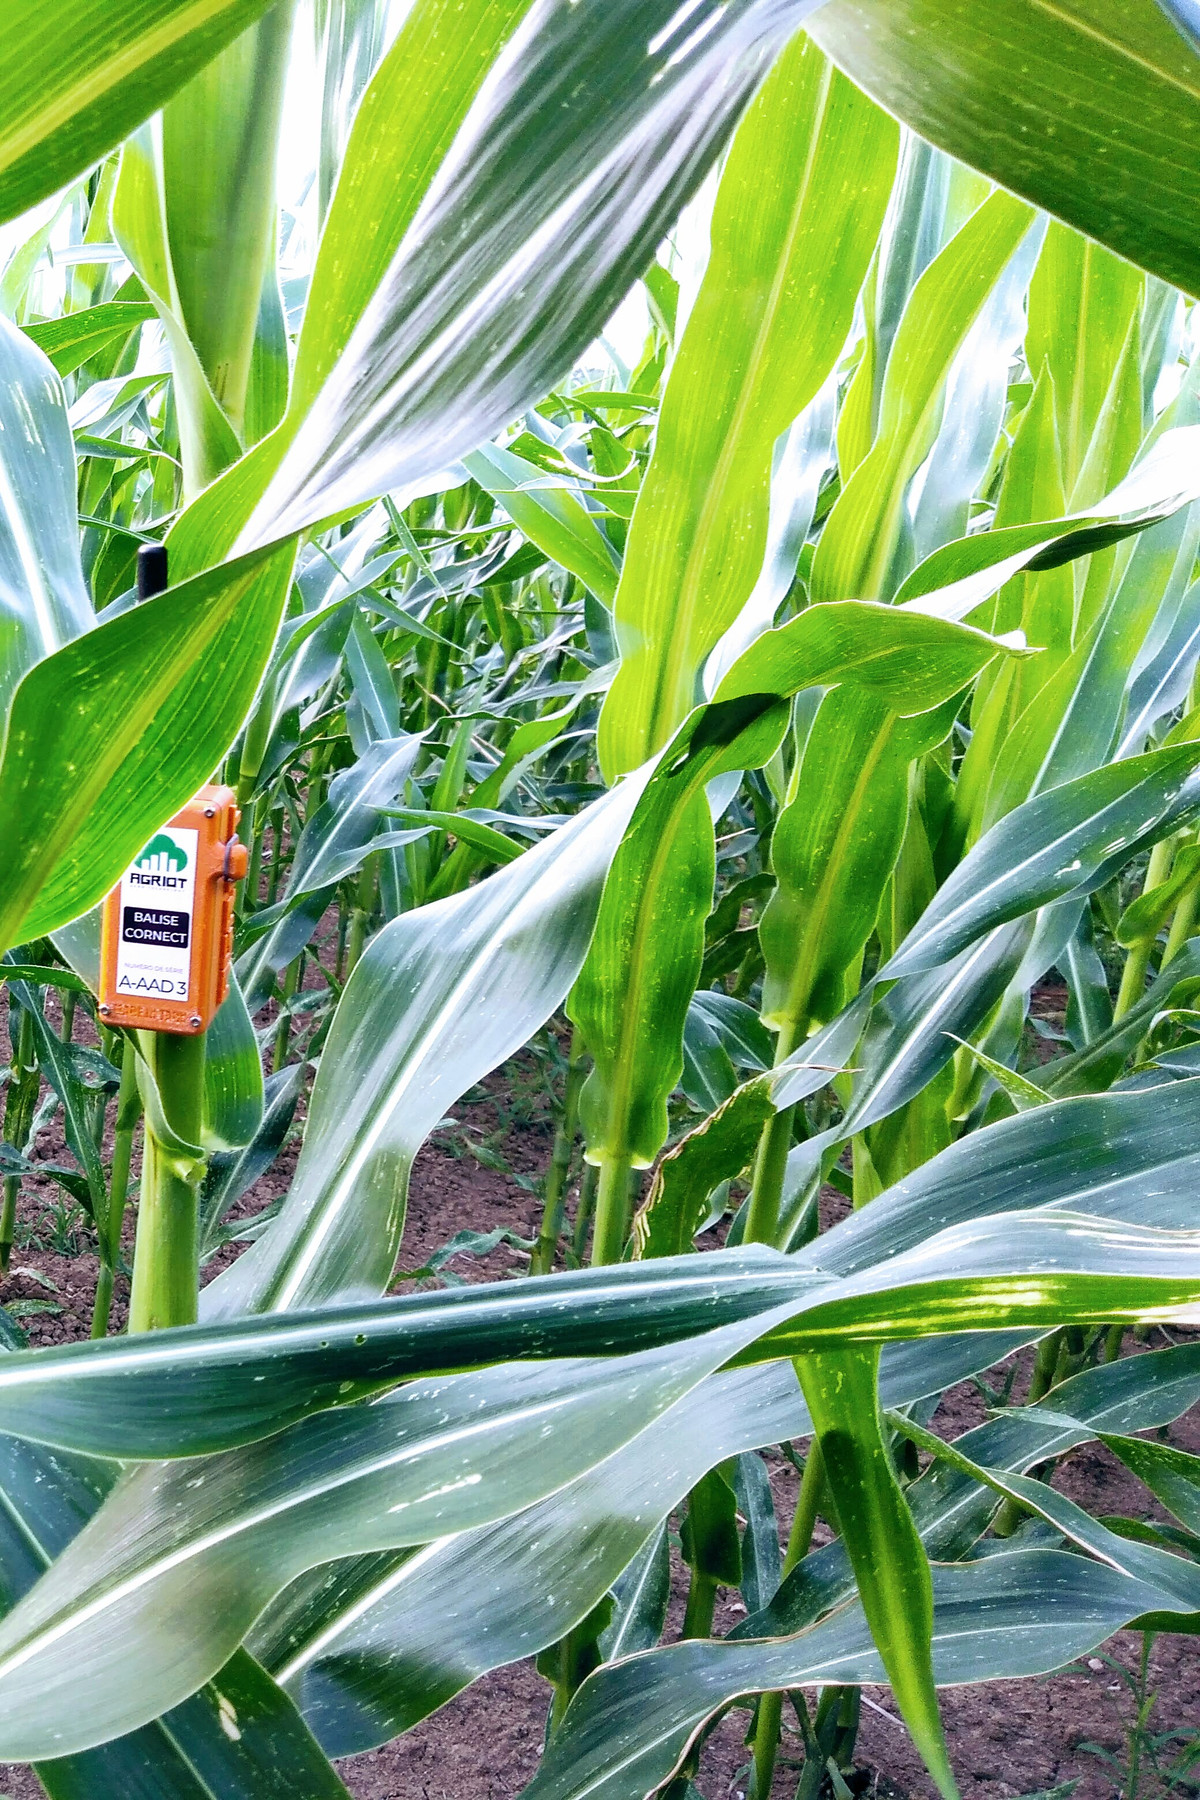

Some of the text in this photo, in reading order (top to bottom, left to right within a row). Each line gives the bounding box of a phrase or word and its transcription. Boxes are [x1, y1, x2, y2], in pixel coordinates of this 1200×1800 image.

[130, 873, 187, 889] AGRIOT
[134, 912, 180, 927] BALISE
[124, 927, 187, 944] CORNECT
